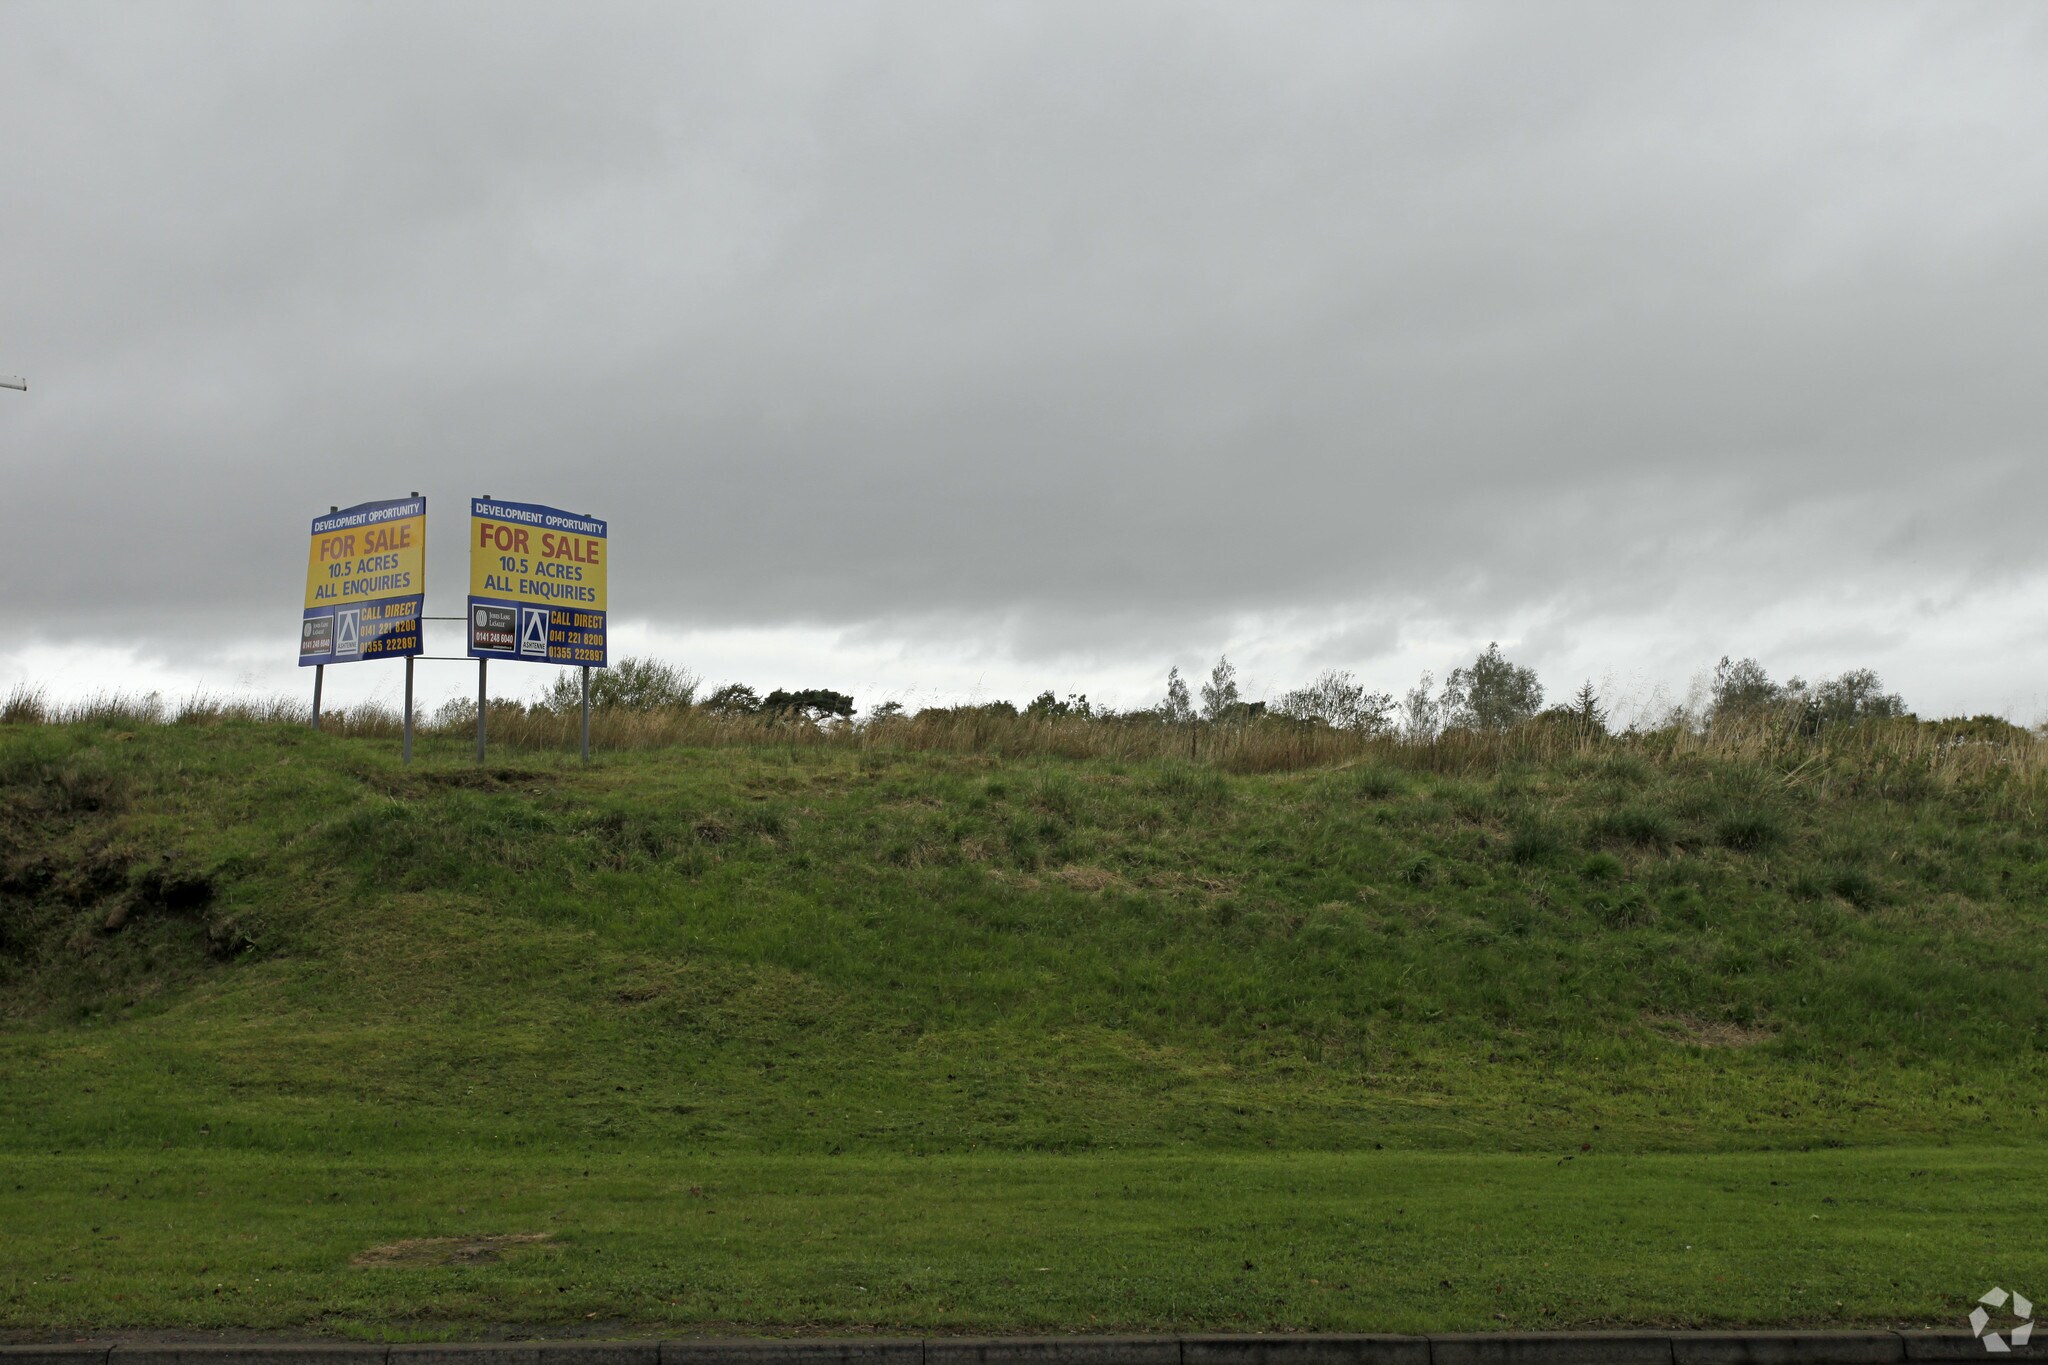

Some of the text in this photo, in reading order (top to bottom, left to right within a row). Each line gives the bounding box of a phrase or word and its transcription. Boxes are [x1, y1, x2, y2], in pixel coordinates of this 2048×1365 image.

[314, 503, 420, 532] DEVELOPMENT OPPORTUNITY
[476, 502, 603, 534] DEVELOPMENT OPPORTUNITY
[320, 524, 411, 561] FOR SALE
[480, 522, 599, 565] FOR SALE
[328, 553, 398, 578] 10.5 ACRES
[499, 556, 583, 581] 10.5 ACRES
[315, 572, 410, 599] ALL ENQUIRIES
[484, 574, 596, 602] ALL ENQUIRIES
[361, 601, 417, 621] CALL DIRECT
[551, 610, 604, 629] CALL DIRECT
[360, 619, 416, 637] 0141 221 8200
[476, 632, 514, 644] 0141 248 6040
[549, 630, 603, 646] 0141 221 8200
[360, 637, 417, 653] 01355 222897
[522, 641, 546, 650] ASHTENNE
[548, 646, 604, 662] 01355 222897
